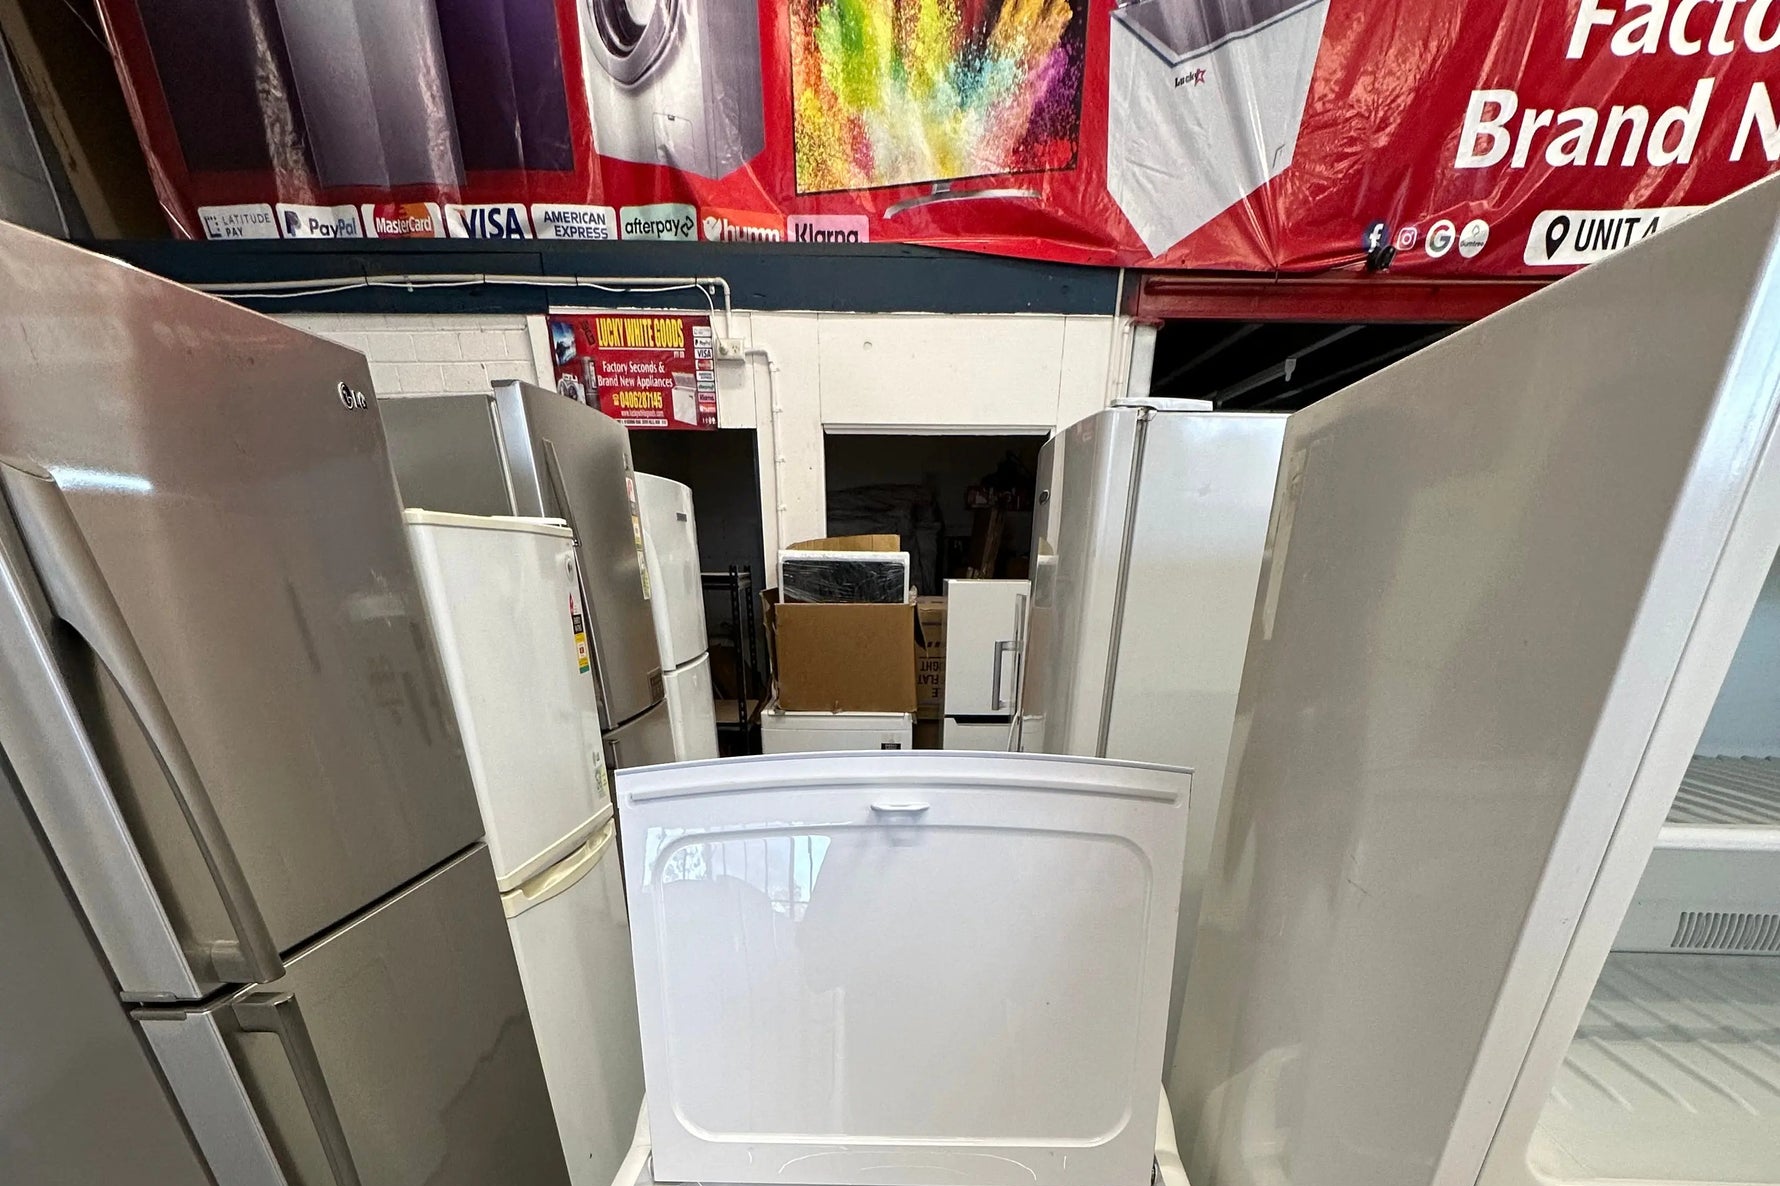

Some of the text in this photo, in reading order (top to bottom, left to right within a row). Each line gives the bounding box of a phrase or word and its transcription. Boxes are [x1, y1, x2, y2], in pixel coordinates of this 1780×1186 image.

[1454, 78, 1716, 169] Brand
[221, 212, 271, 225] LATITUDE
[375, 215, 432, 234] MasterCard
[458, 207, 525, 240] VISA
[543, 210, 606, 225] AMERICAN
[225, 226, 244, 238] PAY
[309, 217, 358, 240] PayPal
[554, 225, 609, 240] EXPRESS
[624, 216, 680, 240] afterpay
[723, 217, 781, 242] humm
[1574, 217, 1641, 252] UNIT
[596, 317, 685, 348] LUCKY WHITE GOODS
[697, 349, 711, 358] VISA
[602, 361, 665, 375] Factory Seconds &
[598, 374, 673, 390] Brand New Appliances
